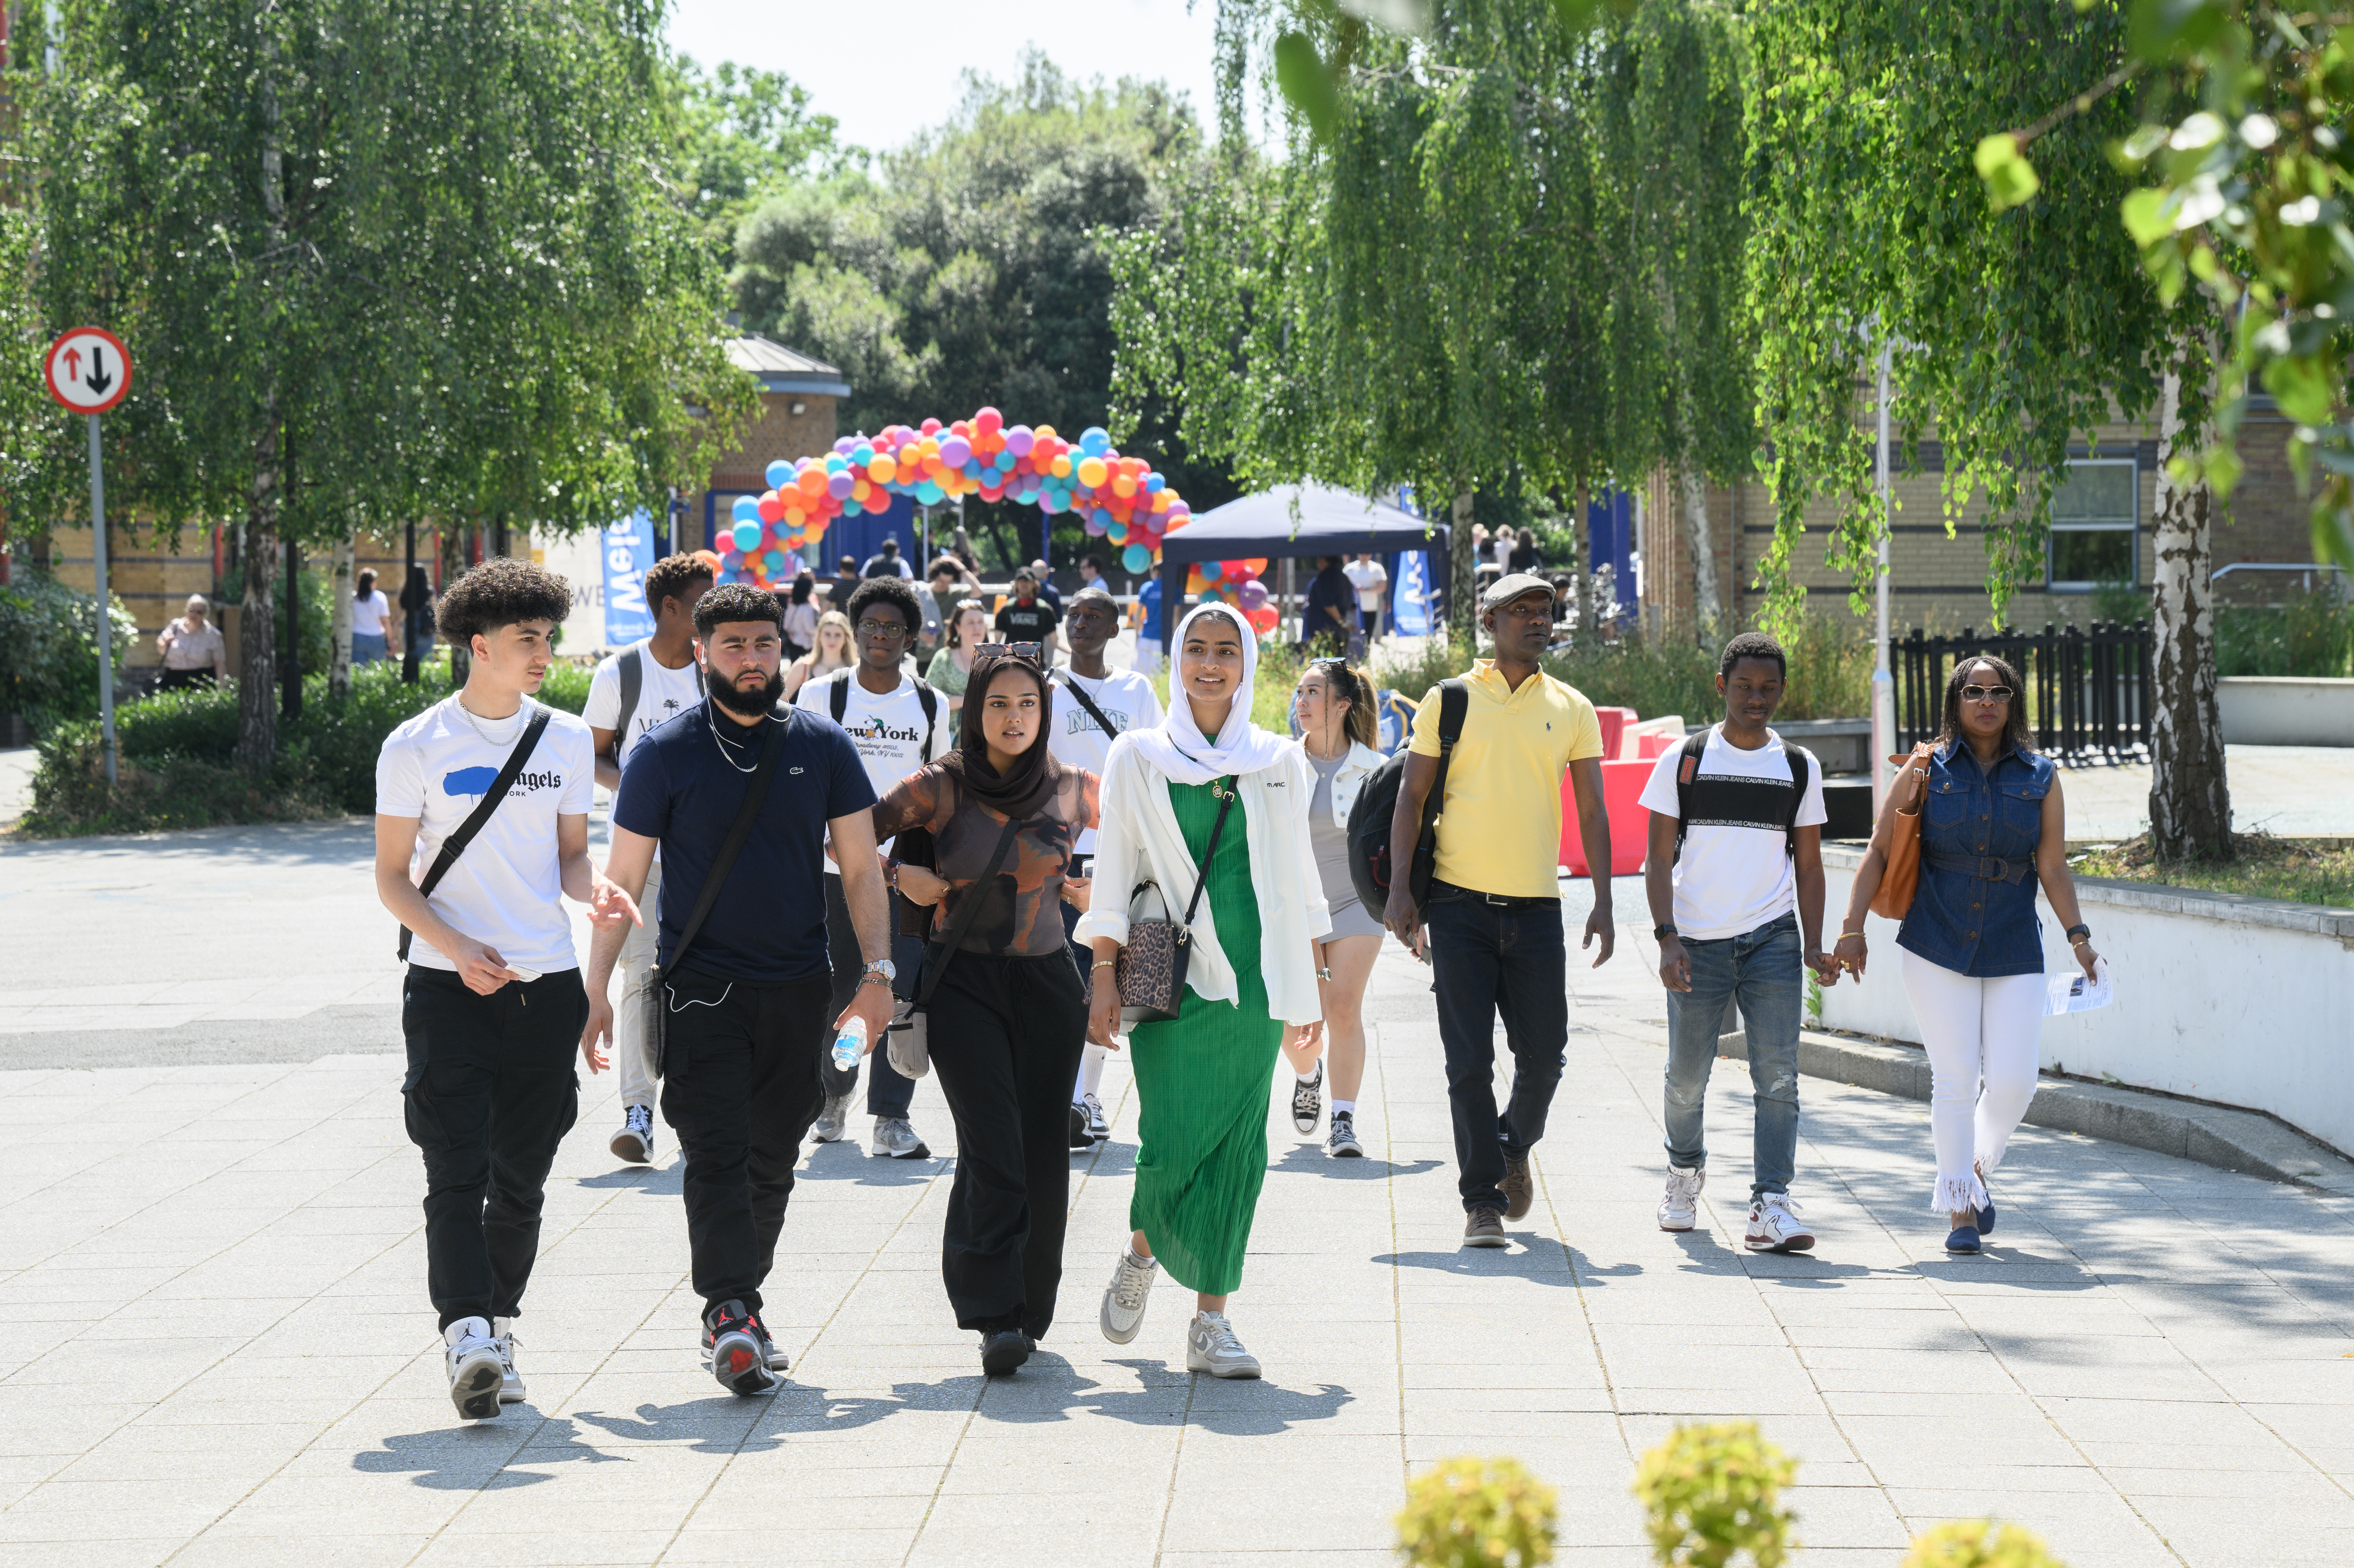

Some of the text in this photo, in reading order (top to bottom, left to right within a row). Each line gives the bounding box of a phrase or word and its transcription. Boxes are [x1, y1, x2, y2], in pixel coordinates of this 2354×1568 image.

[1010, 613, 1039, 626] VANS
[845, 726, 918, 741] ew York
[514, 770, 561, 791] ngels
[879, 1127, 890, 1141] N
